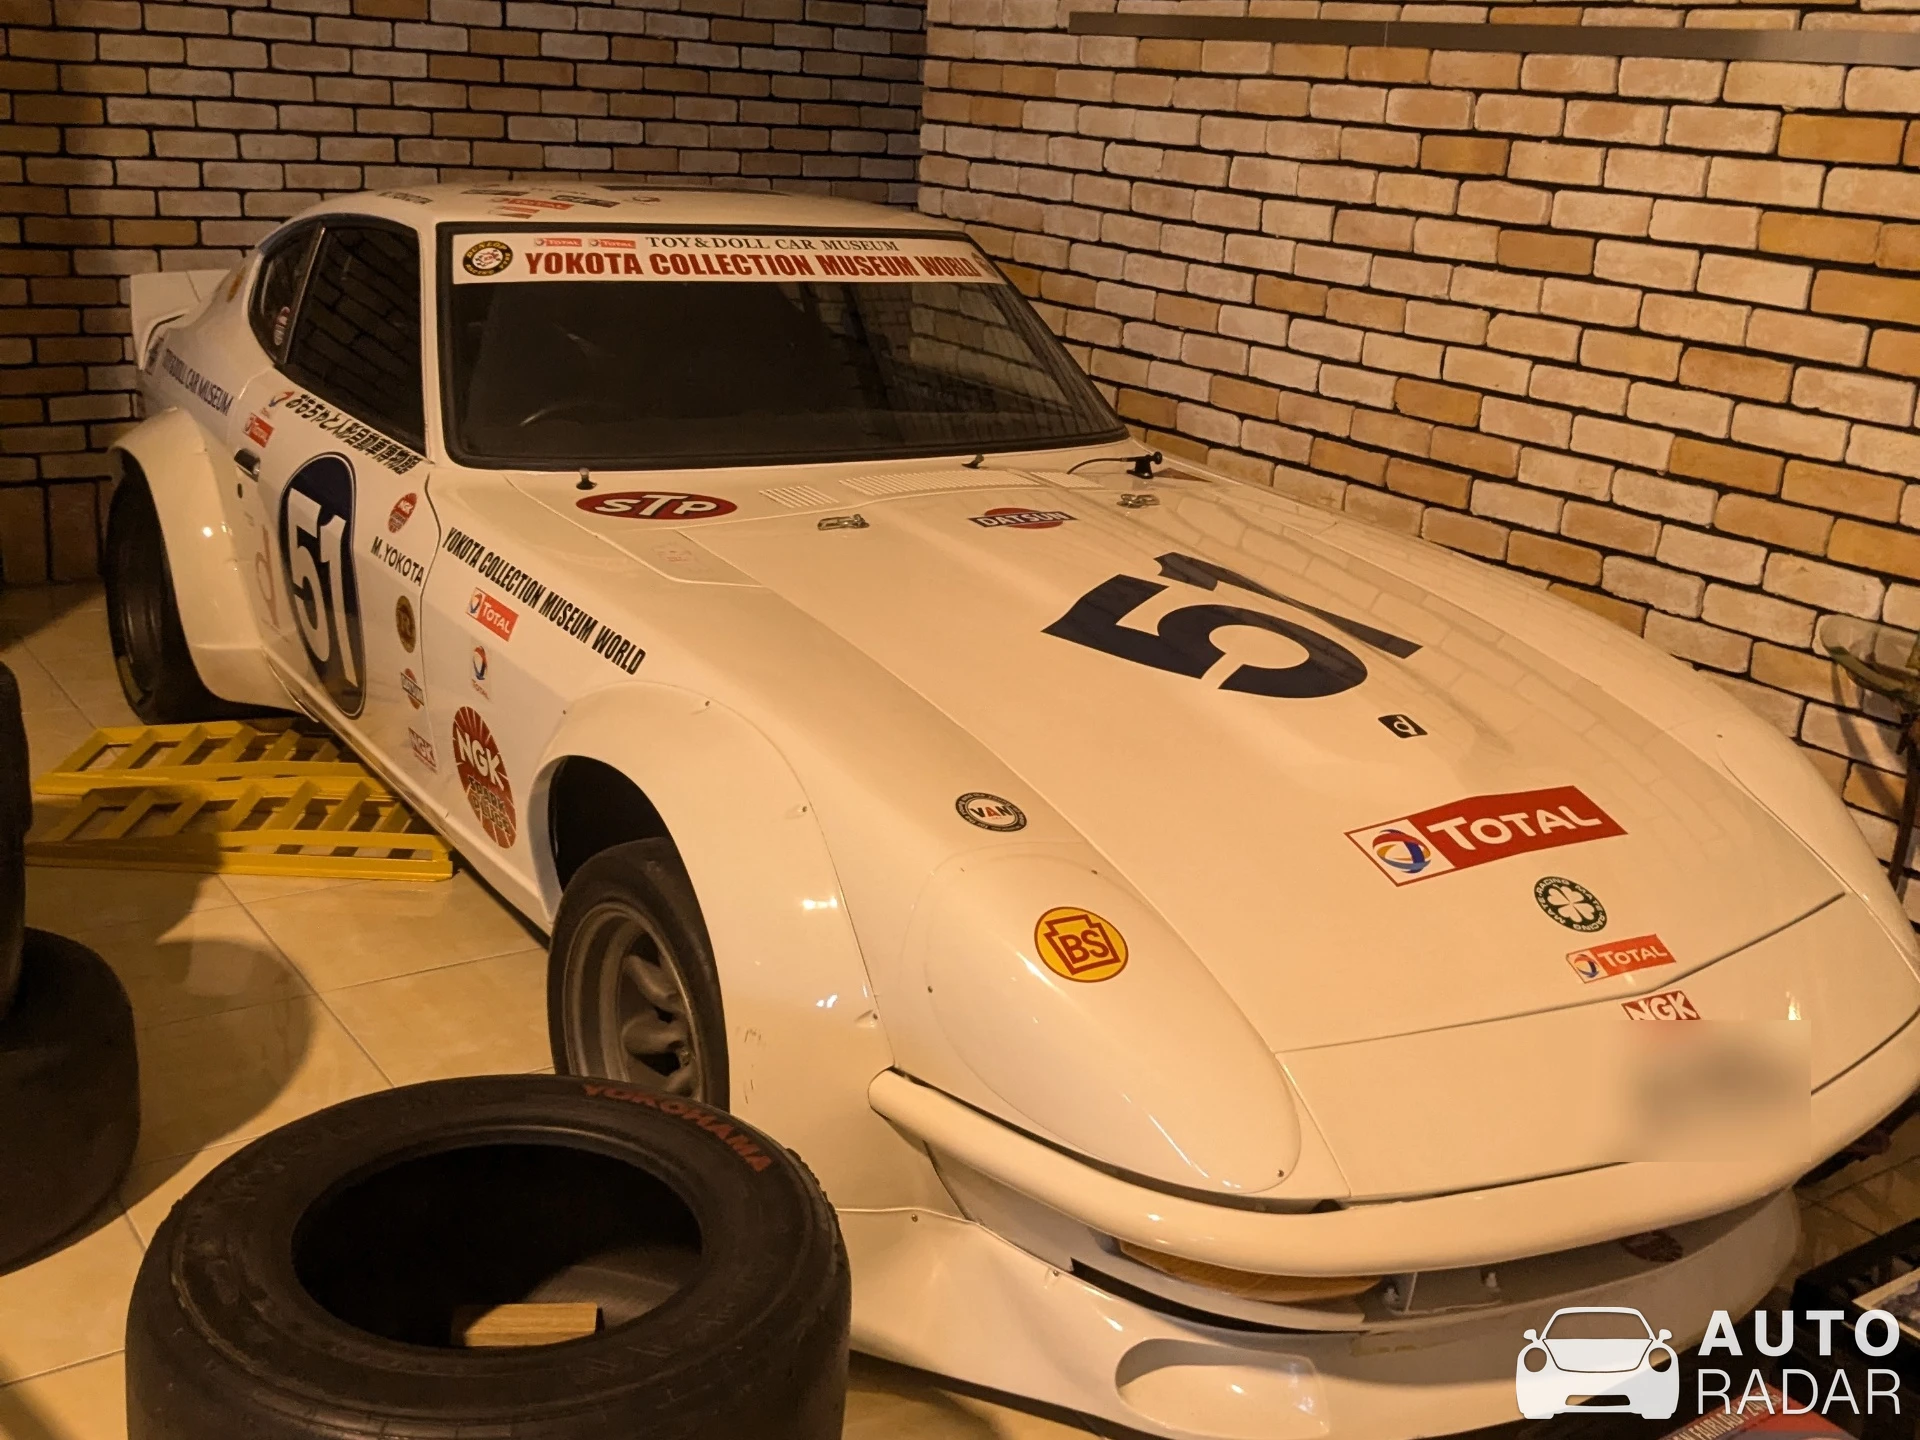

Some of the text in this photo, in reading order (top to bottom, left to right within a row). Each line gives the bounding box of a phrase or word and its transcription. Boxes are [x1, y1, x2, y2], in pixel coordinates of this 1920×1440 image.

[466, 241, 507, 258] DUNLOP
[548, 238, 580, 246] TOTAL
[603, 240, 633, 248] TOTAL
[645, 236, 900, 251] TOY&DOLL CAR MUSEUM
[525, 252, 644, 275] YOKOTA
[649, 253, 815, 276] COLLECTION
[815, 255, 920, 277] MUSEUM
[914, 255, 982, 277] WORLD
[197, 376, 235, 417] MUSEUM
[594, 494, 718, 517] STP
[976, 511, 1071, 526] DATSUN
[287, 487, 359, 688] 51
[442, 526, 647, 676] YOKOTA COLLECTION MUSEUM WORLD
[482, 601, 512, 635] TOTAL
[1041, 552, 1423, 698] 51
[456, 727, 505, 791] NGK
[969, 805, 1014, 818] VAN
[1426, 805, 1603, 851] TOTAL
[1536, 878, 1604, 912] RACING MATE
[1058, 929, 1110, 965] BS
[1596, 945, 1668, 968] TOTAL
[1624, 992, 1698, 1021] NGK
[583, 1084, 772, 1173] YOKOHAMA
